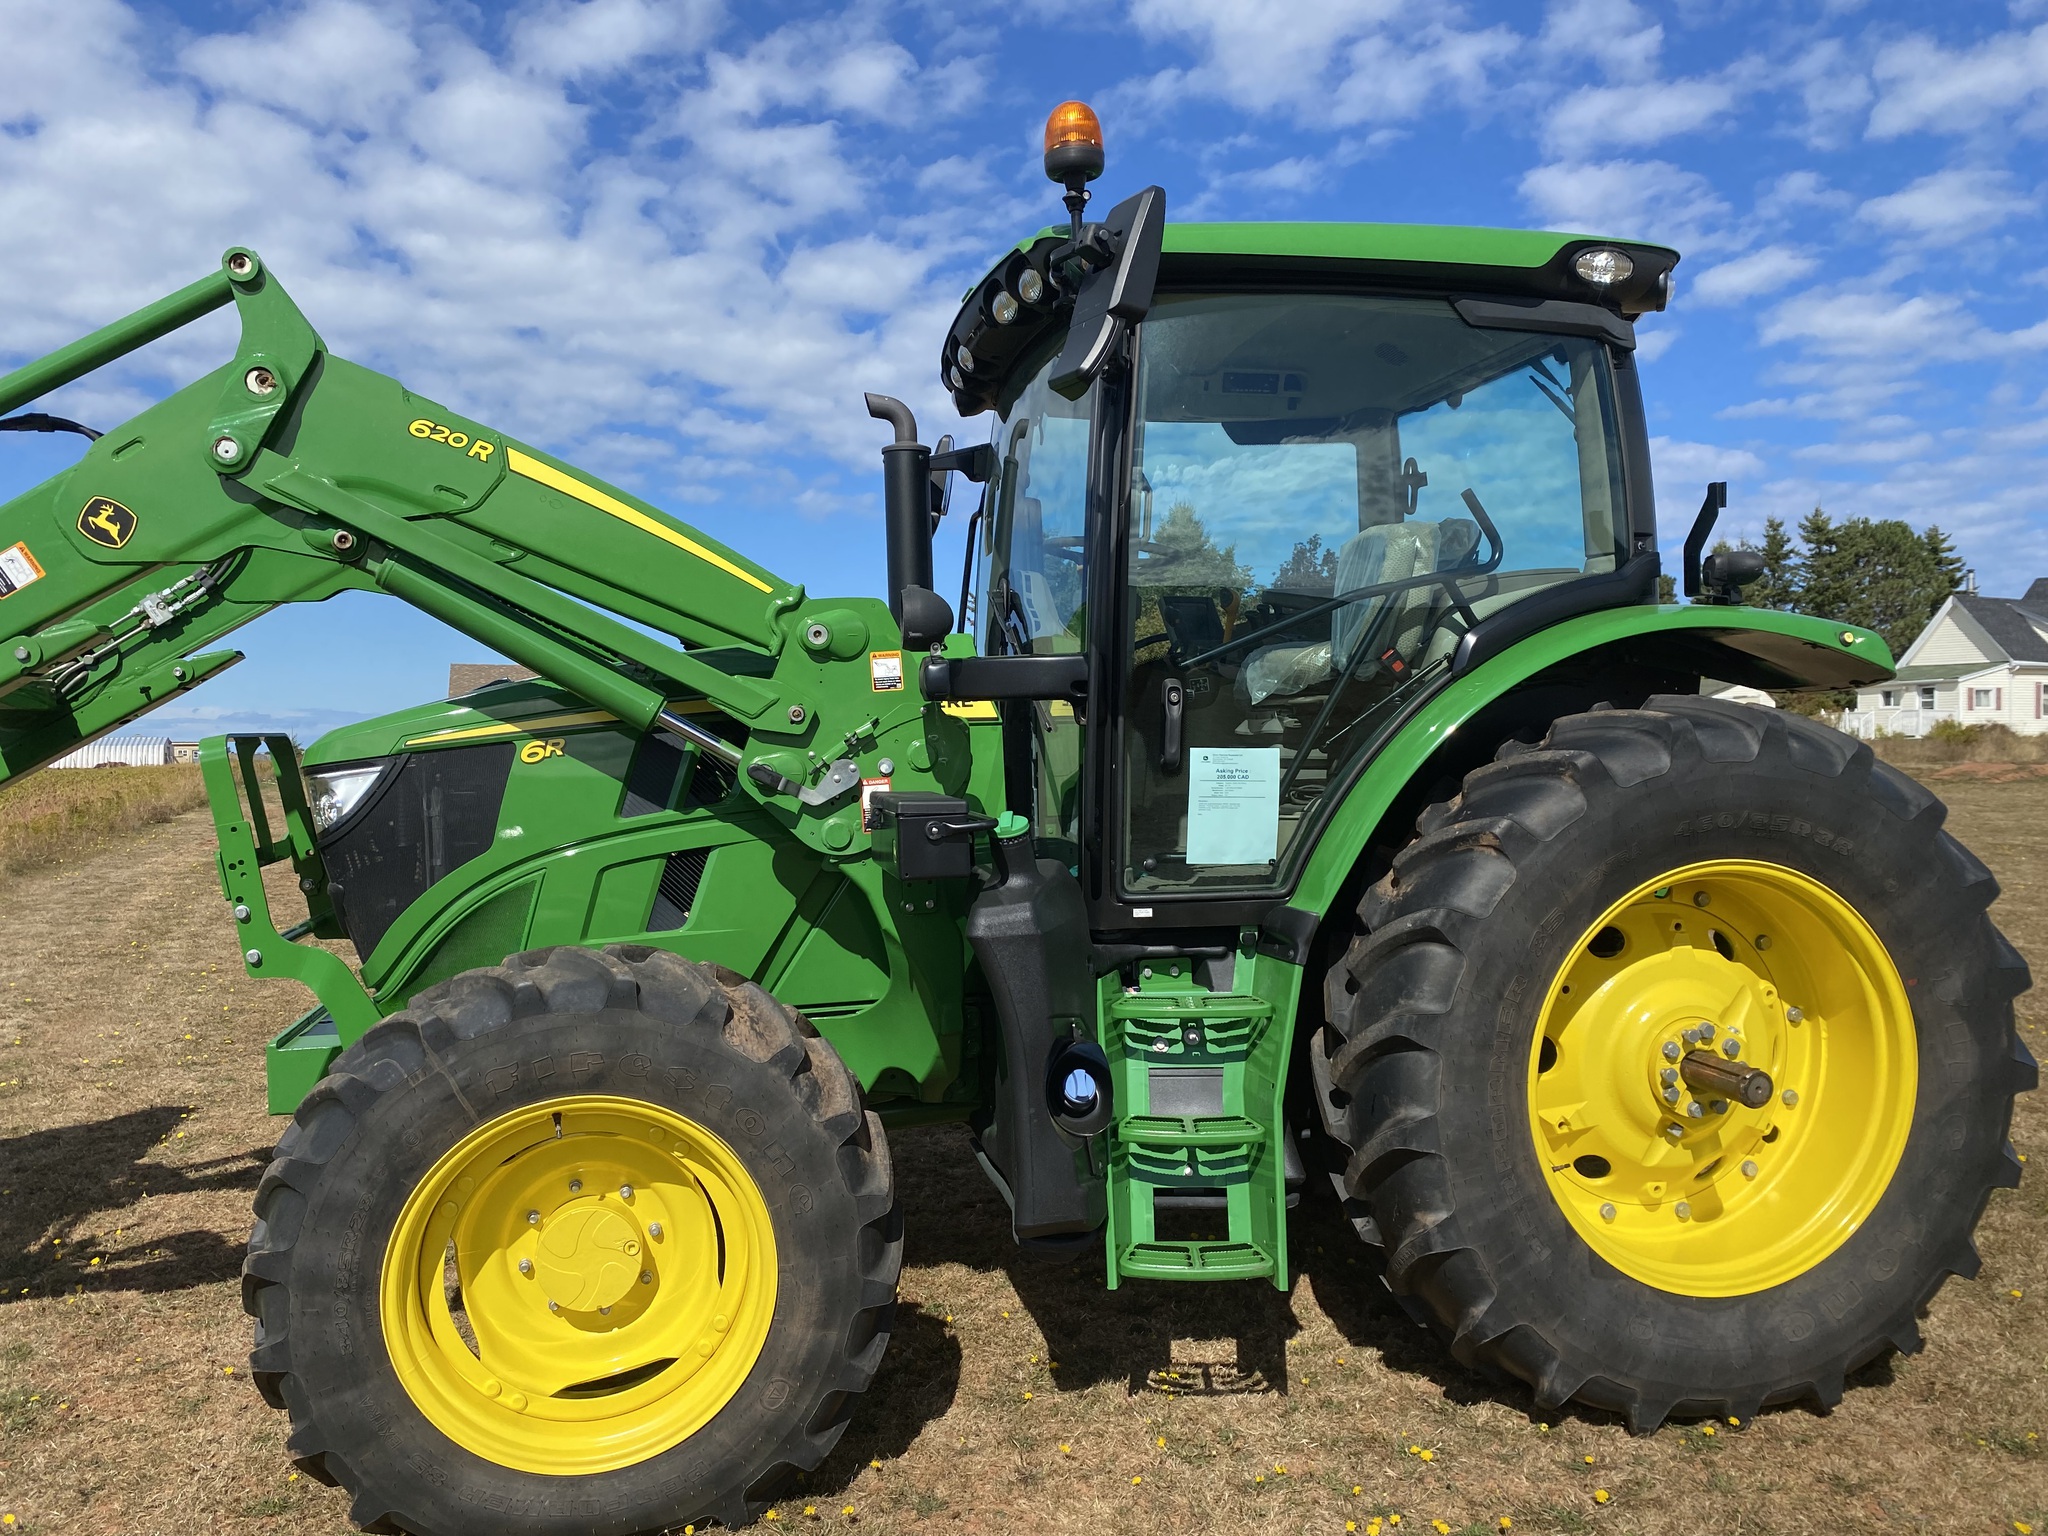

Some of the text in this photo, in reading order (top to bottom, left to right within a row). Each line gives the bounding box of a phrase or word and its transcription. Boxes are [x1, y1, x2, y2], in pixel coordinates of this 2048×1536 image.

[408, 419, 496, 464] 620 R
[24, 551, 41, 573] WARNING
[520, 738, 566, 765] 6R
